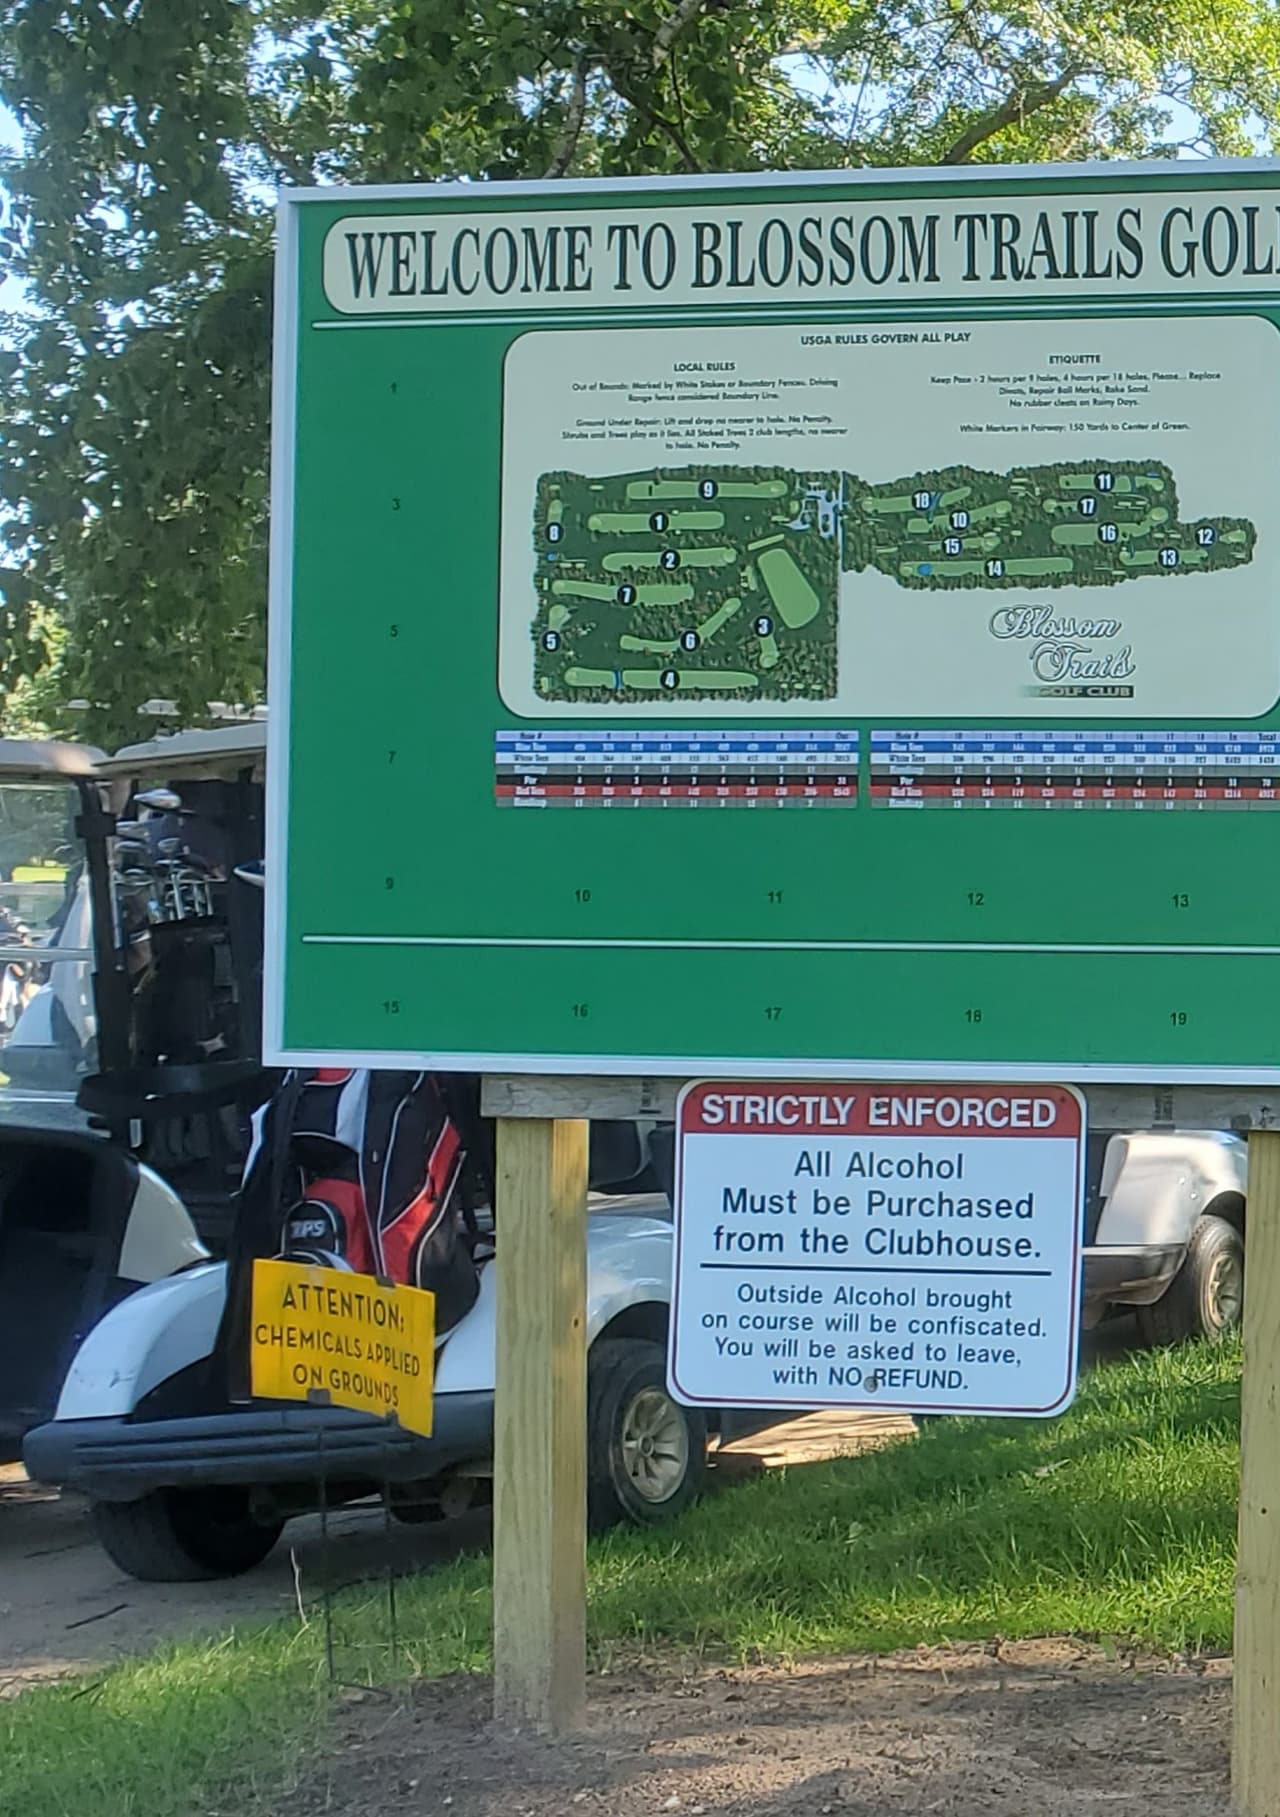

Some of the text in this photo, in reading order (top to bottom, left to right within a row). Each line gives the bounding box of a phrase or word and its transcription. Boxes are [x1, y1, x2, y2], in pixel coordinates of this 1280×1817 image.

[345, 226, 592, 298] WELCOME
[608, 223, 675, 290] TO
[691, 215, 940, 288] BLOSSOM
[955, 208, 1143, 281] TRAILS
[800, 332, 971, 346] USGA RULES GOVERN ALL PLAY
[674, 362, 736, 372] LOCAL RULES
[1049, 355, 1101, 364] ETIQUETTE
[391, 382, 397, 393] 1
[1098, 474, 1110, 489] 11
[704, 482, 712, 497] 9
[393, 498, 400, 510] 3
[1082, 499, 1094, 513] 17
[656, 515, 662, 530] 1
[952, 513, 966, 527] 10
[1101, 525, 1115, 540] 16
[1198, 529, 1212, 543] 12
[945, 539, 959, 553] 15
[666, 553, 674, 568] 2
[1161, 550, 1175, 565] 13
[988, 561, 1001, 576] 14
[623, 588, 630, 603] 7
[759, 619, 767, 634] 3
[989, 604, 1122, 639] Blossom
[391, 625, 398, 637] 5
[547, 634, 555, 649] 5
[686, 634, 695, 649] 6
[1030, 641, 1136, 682] Trails
[665, 672, 674, 687] 4
[1038, 686, 1131, 697] GOLF CLUB
[389, 751, 396, 763] 7
[386, 877, 394, 889] 9
[576, 890, 590, 902] 10
[768, 891, 781, 903] 11
[968, 893, 984, 905] 12
[1173, 894, 1188, 907] 13
[383, 1001, 399, 1013] 15
[572, 1004, 587, 1017] 16
[765, 1007, 782, 1020] 17
[966, 1010, 981, 1022] 18
[1170, 1013, 1186, 1025] 19
[701, 1094, 1057, 1128] STRICTLY ENFORCED
[795, 1151, 962, 1179] All Alcohol
[723, 1188, 1033, 1218] Must be Purchased
[714, 1226, 1040, 1257] from the Clubhouse.
[738, 1284, 1011, 1312] Outside Alcohol brought
[282, 1283, 405, 1332] ATTENTION:
[702, 1313, 1045, 1336] on course will be confiscated.
[254, 1324, 420, 1377] CHEMICALS APPLIED
[716, 1337, 1020, 1365] You will be asked to leave,
[293, 1363, 399, 1407] ON GROUNDS
[773, 1366, 969, 1389] with NO REFUND.
